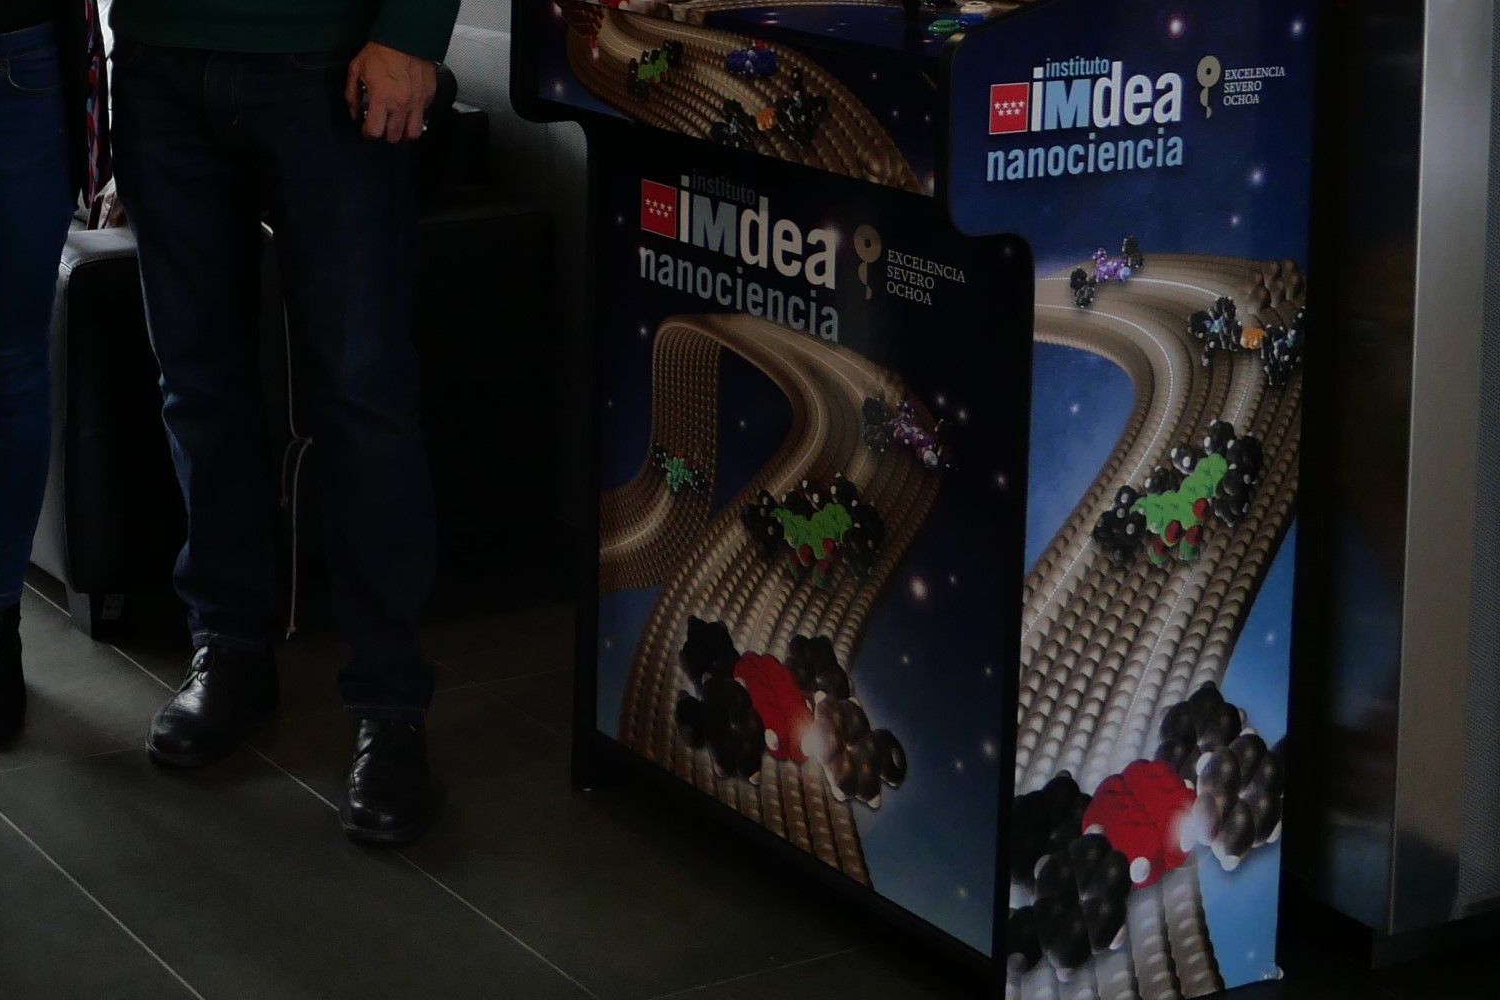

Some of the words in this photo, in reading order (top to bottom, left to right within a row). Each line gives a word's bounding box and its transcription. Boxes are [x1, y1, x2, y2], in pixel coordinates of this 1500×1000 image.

[1045, 56, 1110, 78] instituto
[1224, 66, 1286, 81] EXCELENCIA
[1223, 80, 1262, 93] SEVERO
[1223, 93, 1259, 106] OCHOA
[987, 127, 1183, 181] nanociencia
[692, 169, 755, 206] instituto
[887, 249, 965, 284] EXCELENCIA
[887, 265, 935, 290] SEVERO
[640, 246, 839, 343] nanociencia
[886, 281, 932, 305] OCHOA
